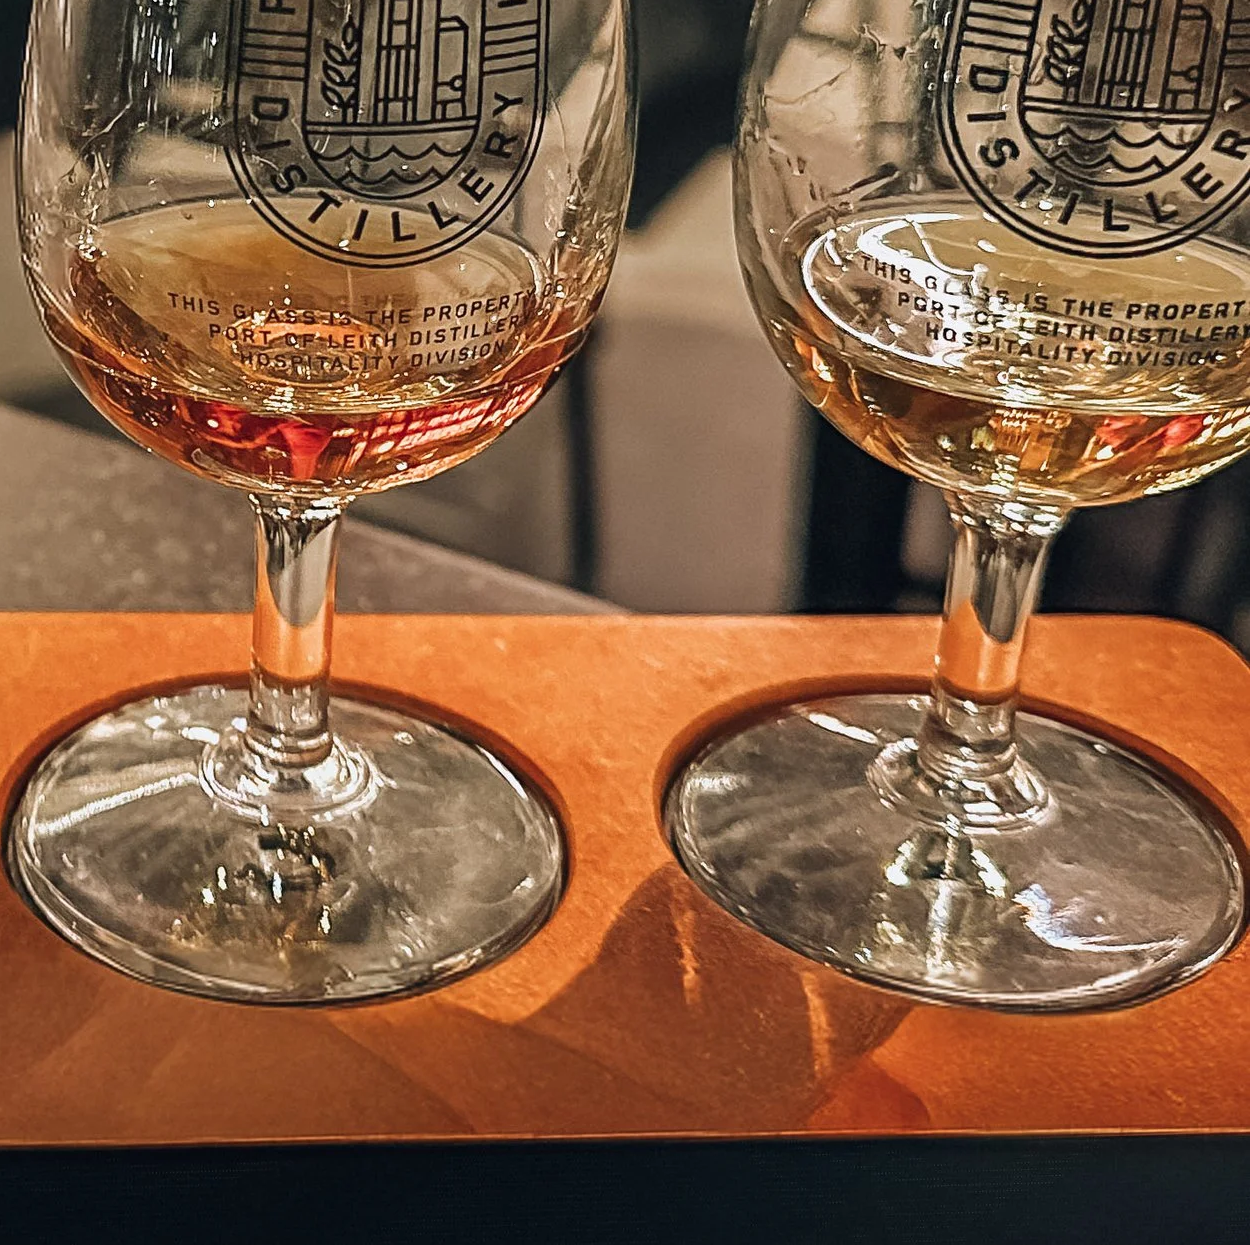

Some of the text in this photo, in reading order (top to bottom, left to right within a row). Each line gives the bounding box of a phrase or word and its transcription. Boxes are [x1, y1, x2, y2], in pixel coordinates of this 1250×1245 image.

[252, 92, 523, 243] DISTILLERY
[167, 292, 220, 316] THIS
[329, 311, 351, 326] IS
[365, 309, 411, 325] THE
[423, 287, 536, 322] PROPERTY
[860, 255, 911, 284] THIS
[1023, 293, 1048, 311] IS
[1062, 298, 1114, 318] THE
[209, 324, 271, 345] PORT
[285, 333, 316, 348] OF
[327, 332, 397, 349] LEITH
[898, 292, 960, 319] PORT
[1019, 317, 1095, 341] LEITH
[240, 339, 504, 371] HOSPITALITY DIVISION
[925, 322, 1222, 367] HOSPITALITY DIVISION
